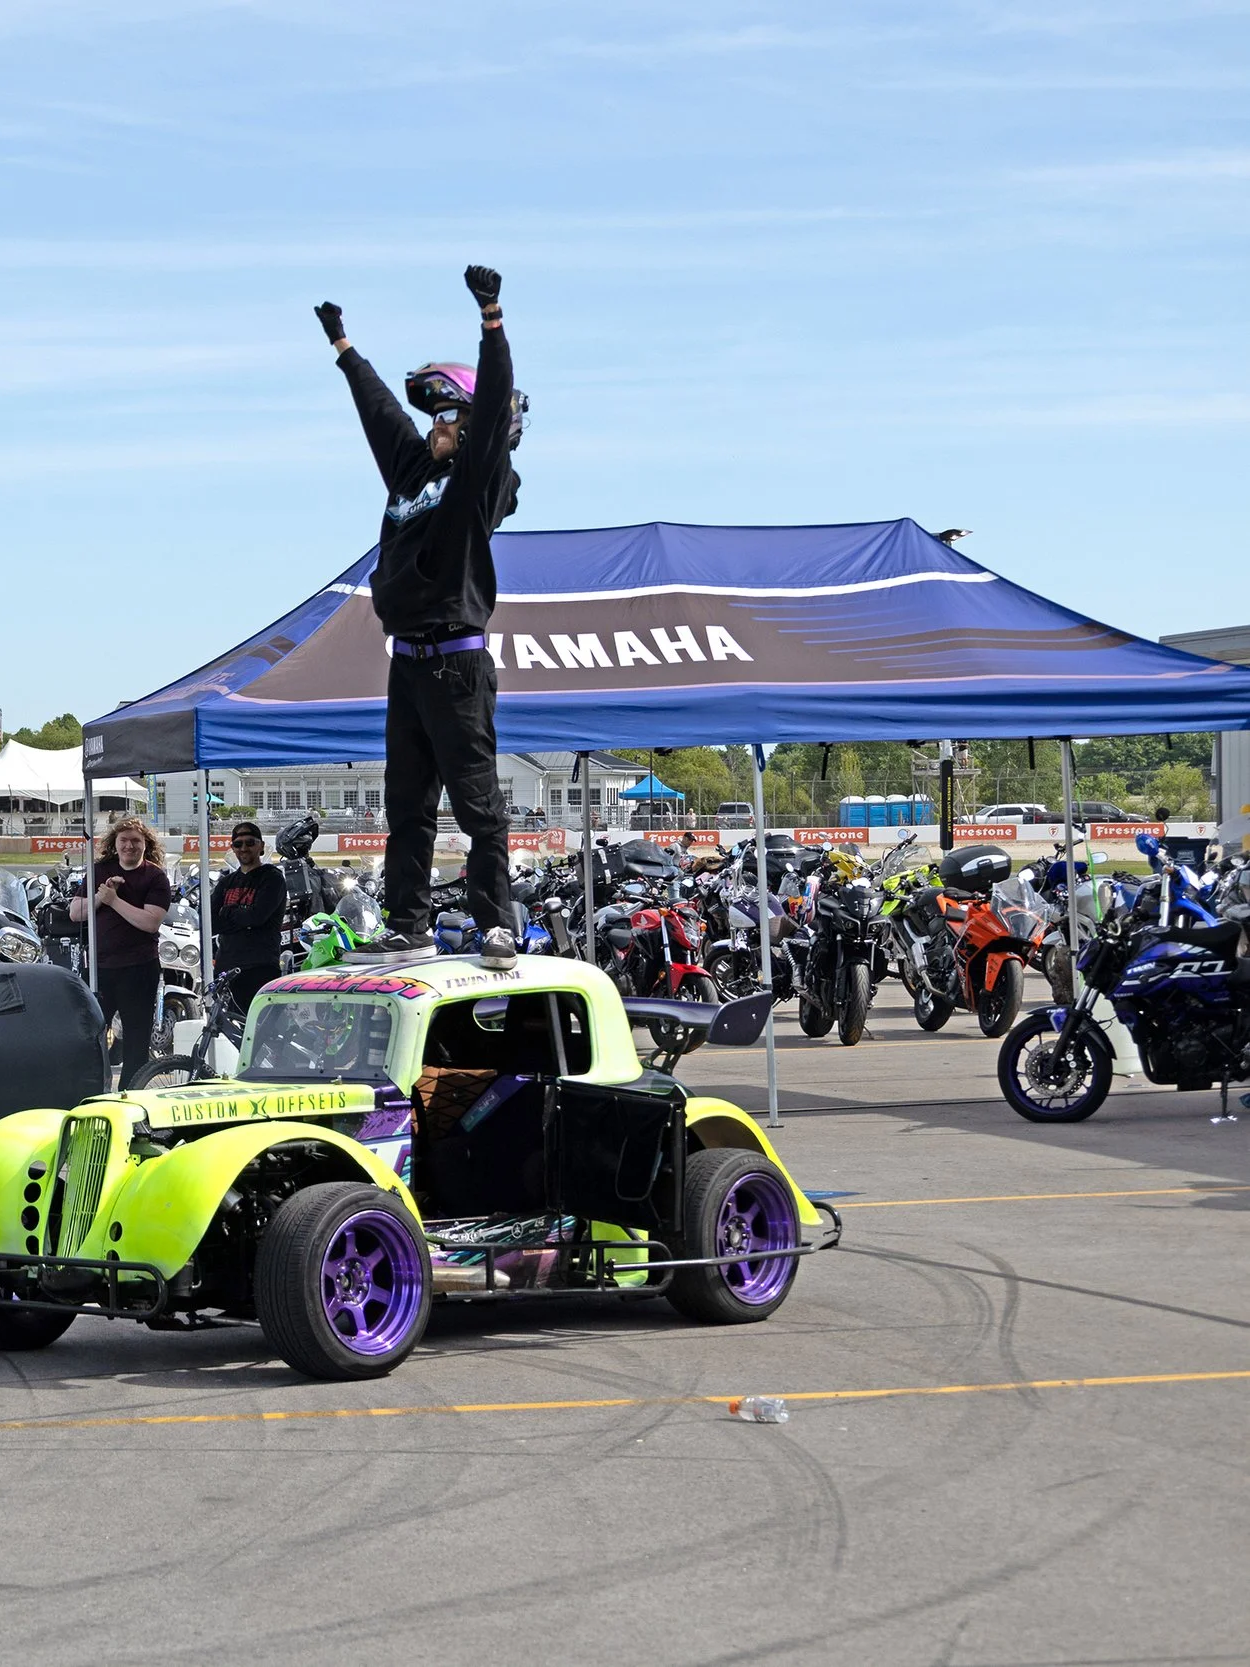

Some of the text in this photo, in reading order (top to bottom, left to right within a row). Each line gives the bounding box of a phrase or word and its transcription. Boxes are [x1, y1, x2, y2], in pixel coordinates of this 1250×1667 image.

[799, 831, 864, 842] Firstone
[1095, 826, 1160, 836] Firestone
[344, 837, 387, 848] Firest
[445, 971, 524, 989] TWIN ONE
[171, 1100, 238, 1123] CUSTOM
[277, 1091, 347, 1113] OFFSETS
